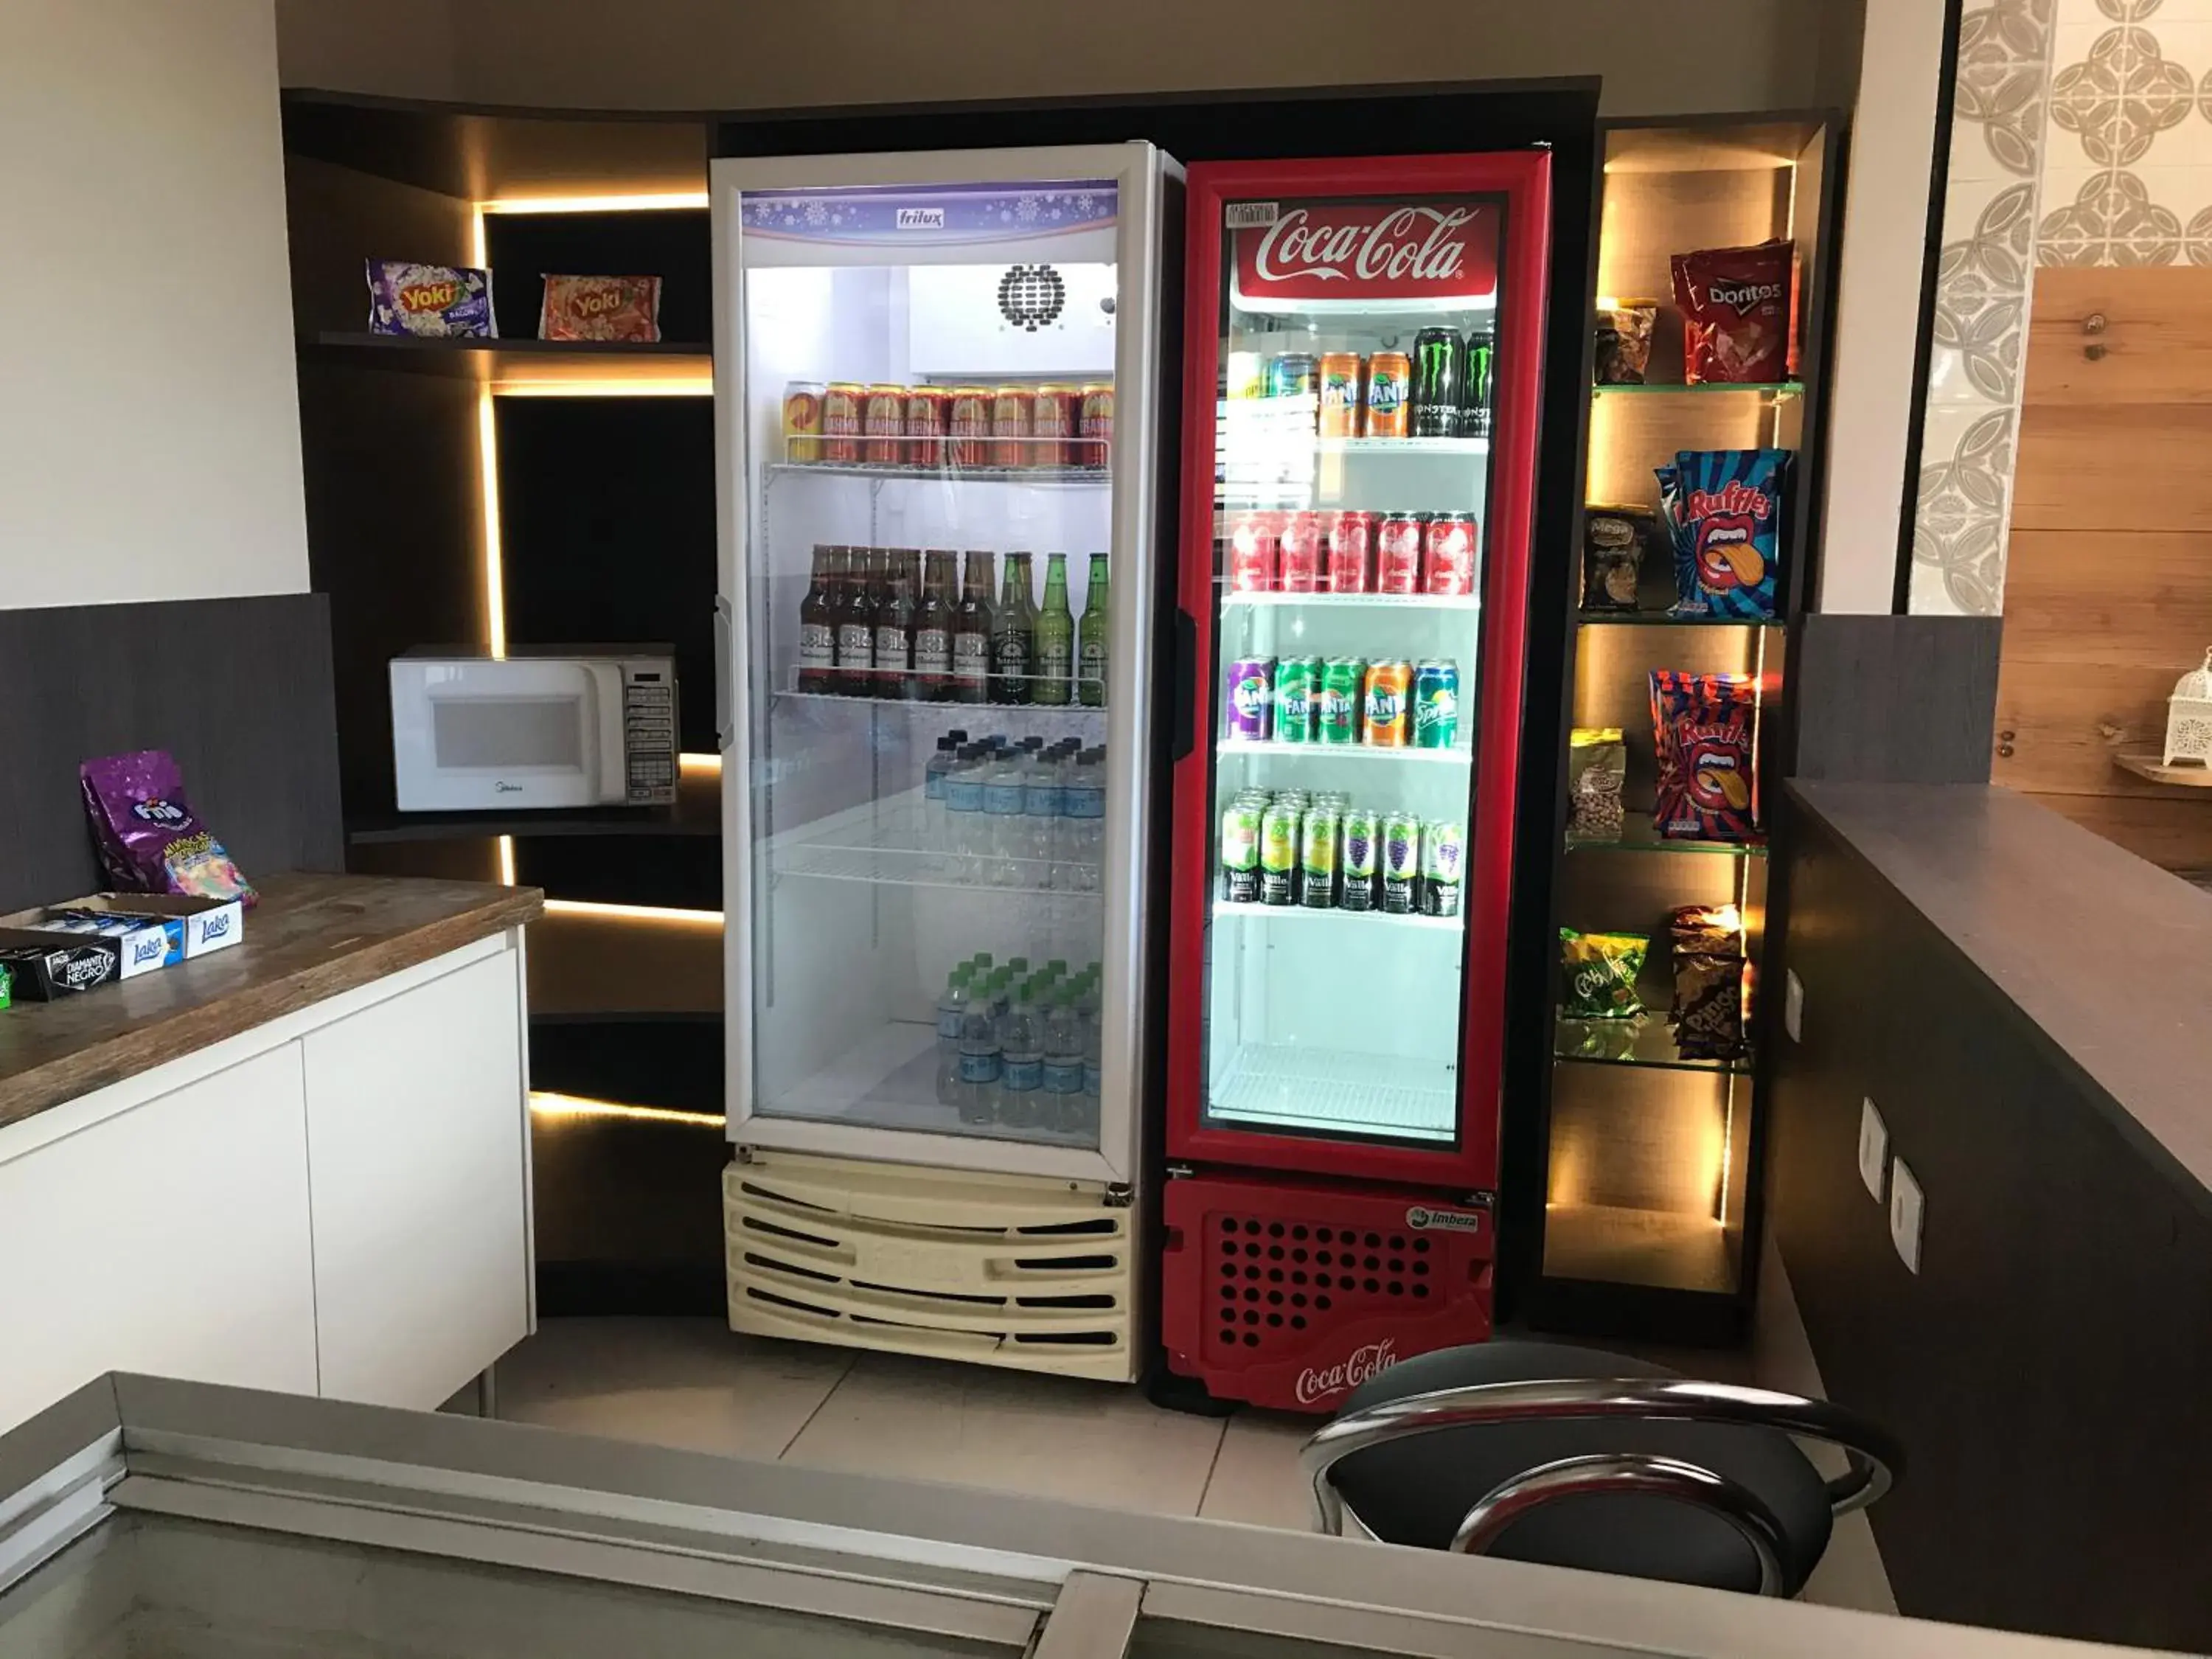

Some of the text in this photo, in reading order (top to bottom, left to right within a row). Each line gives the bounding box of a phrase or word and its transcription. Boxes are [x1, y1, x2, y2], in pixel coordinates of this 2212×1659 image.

[899, 210, 943, 226] frilux
[1256, 207, 1479, 281] Coca-Cola
[403, 283, 453, 310] Yoki
[575, 288, 620, 317] Yoki
[1710, 284, 1781, 304] Doritos
[1688, 481, 1770, 519] Ruffles
[202, 914, 230, 944] Laka
[133, 937, 162, 965] Laka
[67, 965, 103, 984] NEGRO
[1295, 1338, 1398, 1404] Coca-Cola
